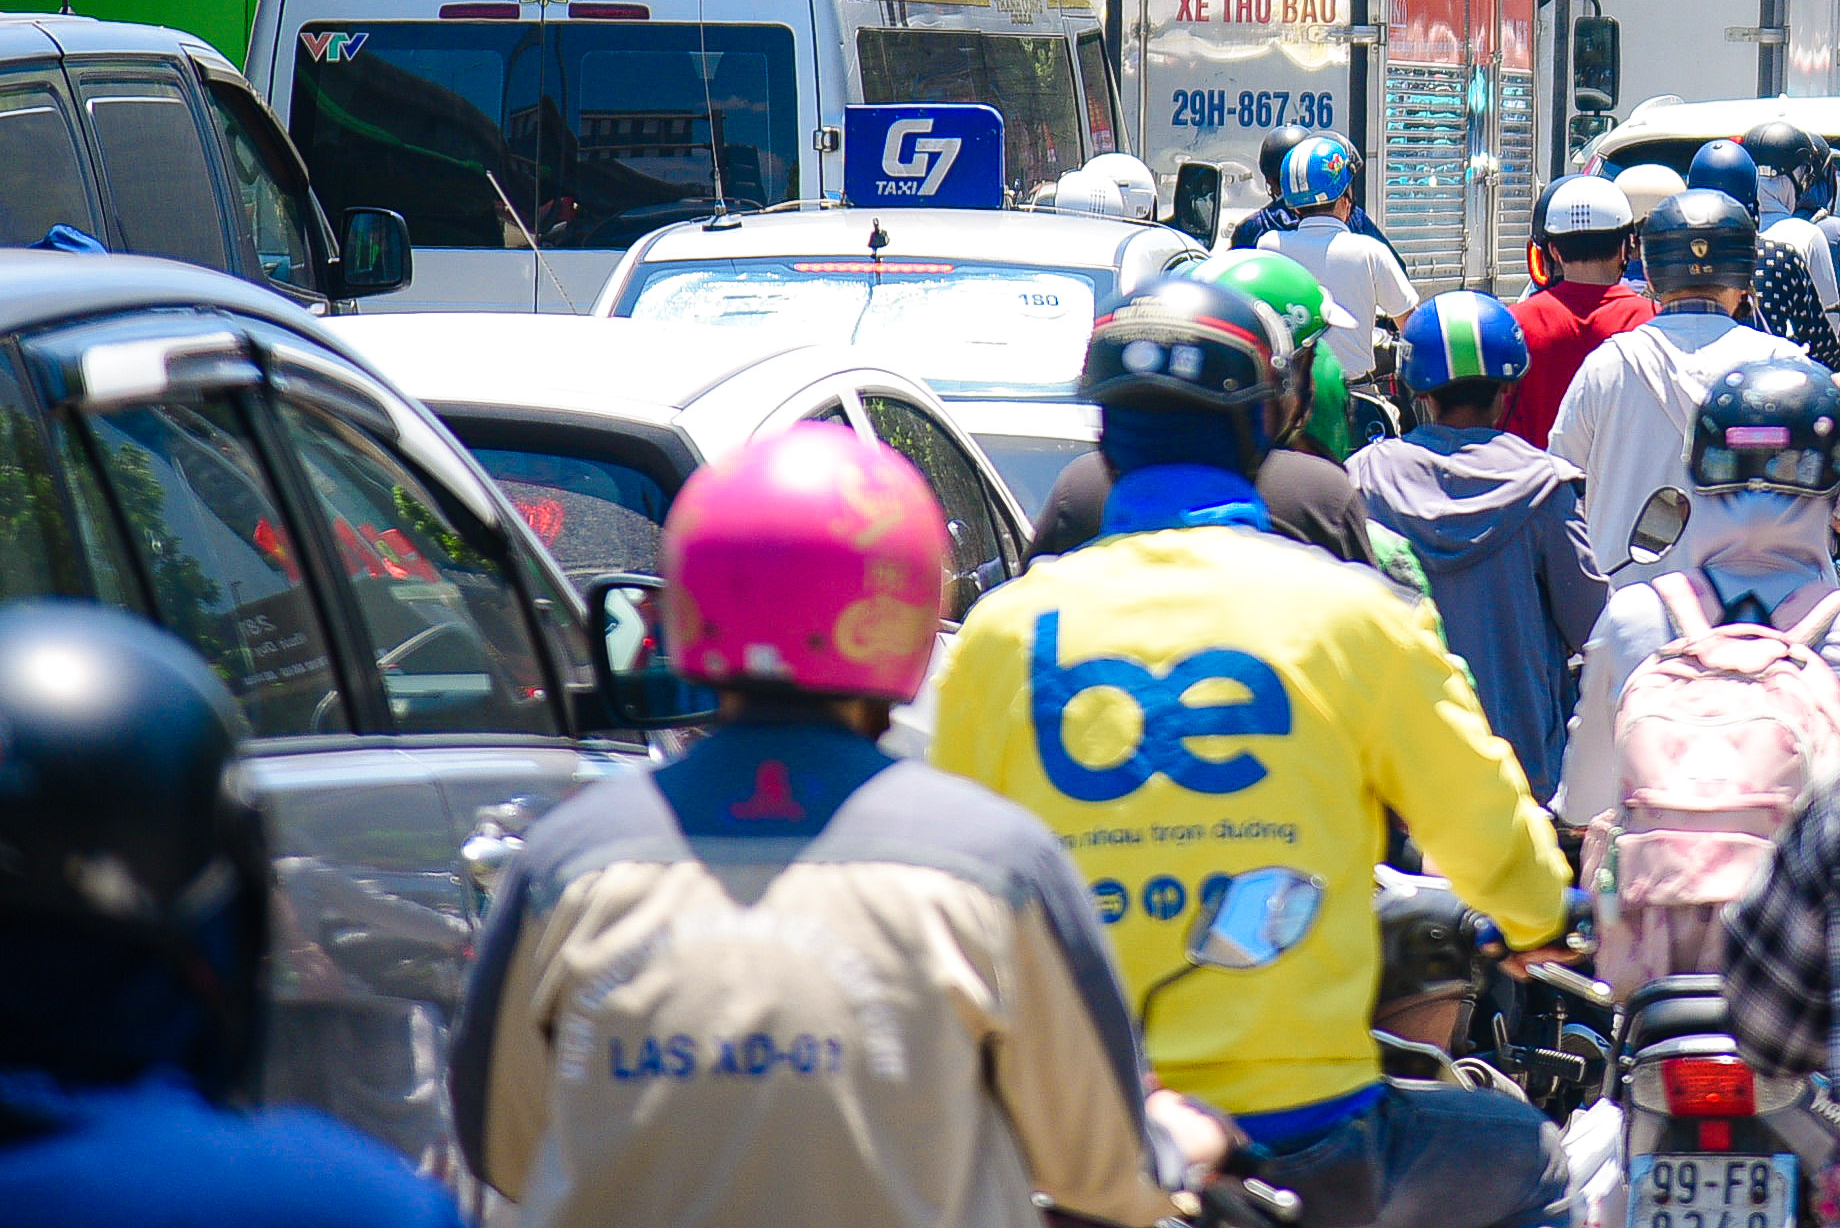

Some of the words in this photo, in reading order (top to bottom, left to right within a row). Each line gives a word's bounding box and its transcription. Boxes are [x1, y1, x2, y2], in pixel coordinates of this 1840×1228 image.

[301, 32, 369, 61] VTV
[1172, 89, 1333, 129] 29H-867.36
[882, 118, 963, 196] G7
[875, 181, 918, 196] TAXI
[1030, 608, 1291, 802] be
[607, 1033, 695, 1080] LAS
[1652, 1160, 1770, 1205] 99-F8
